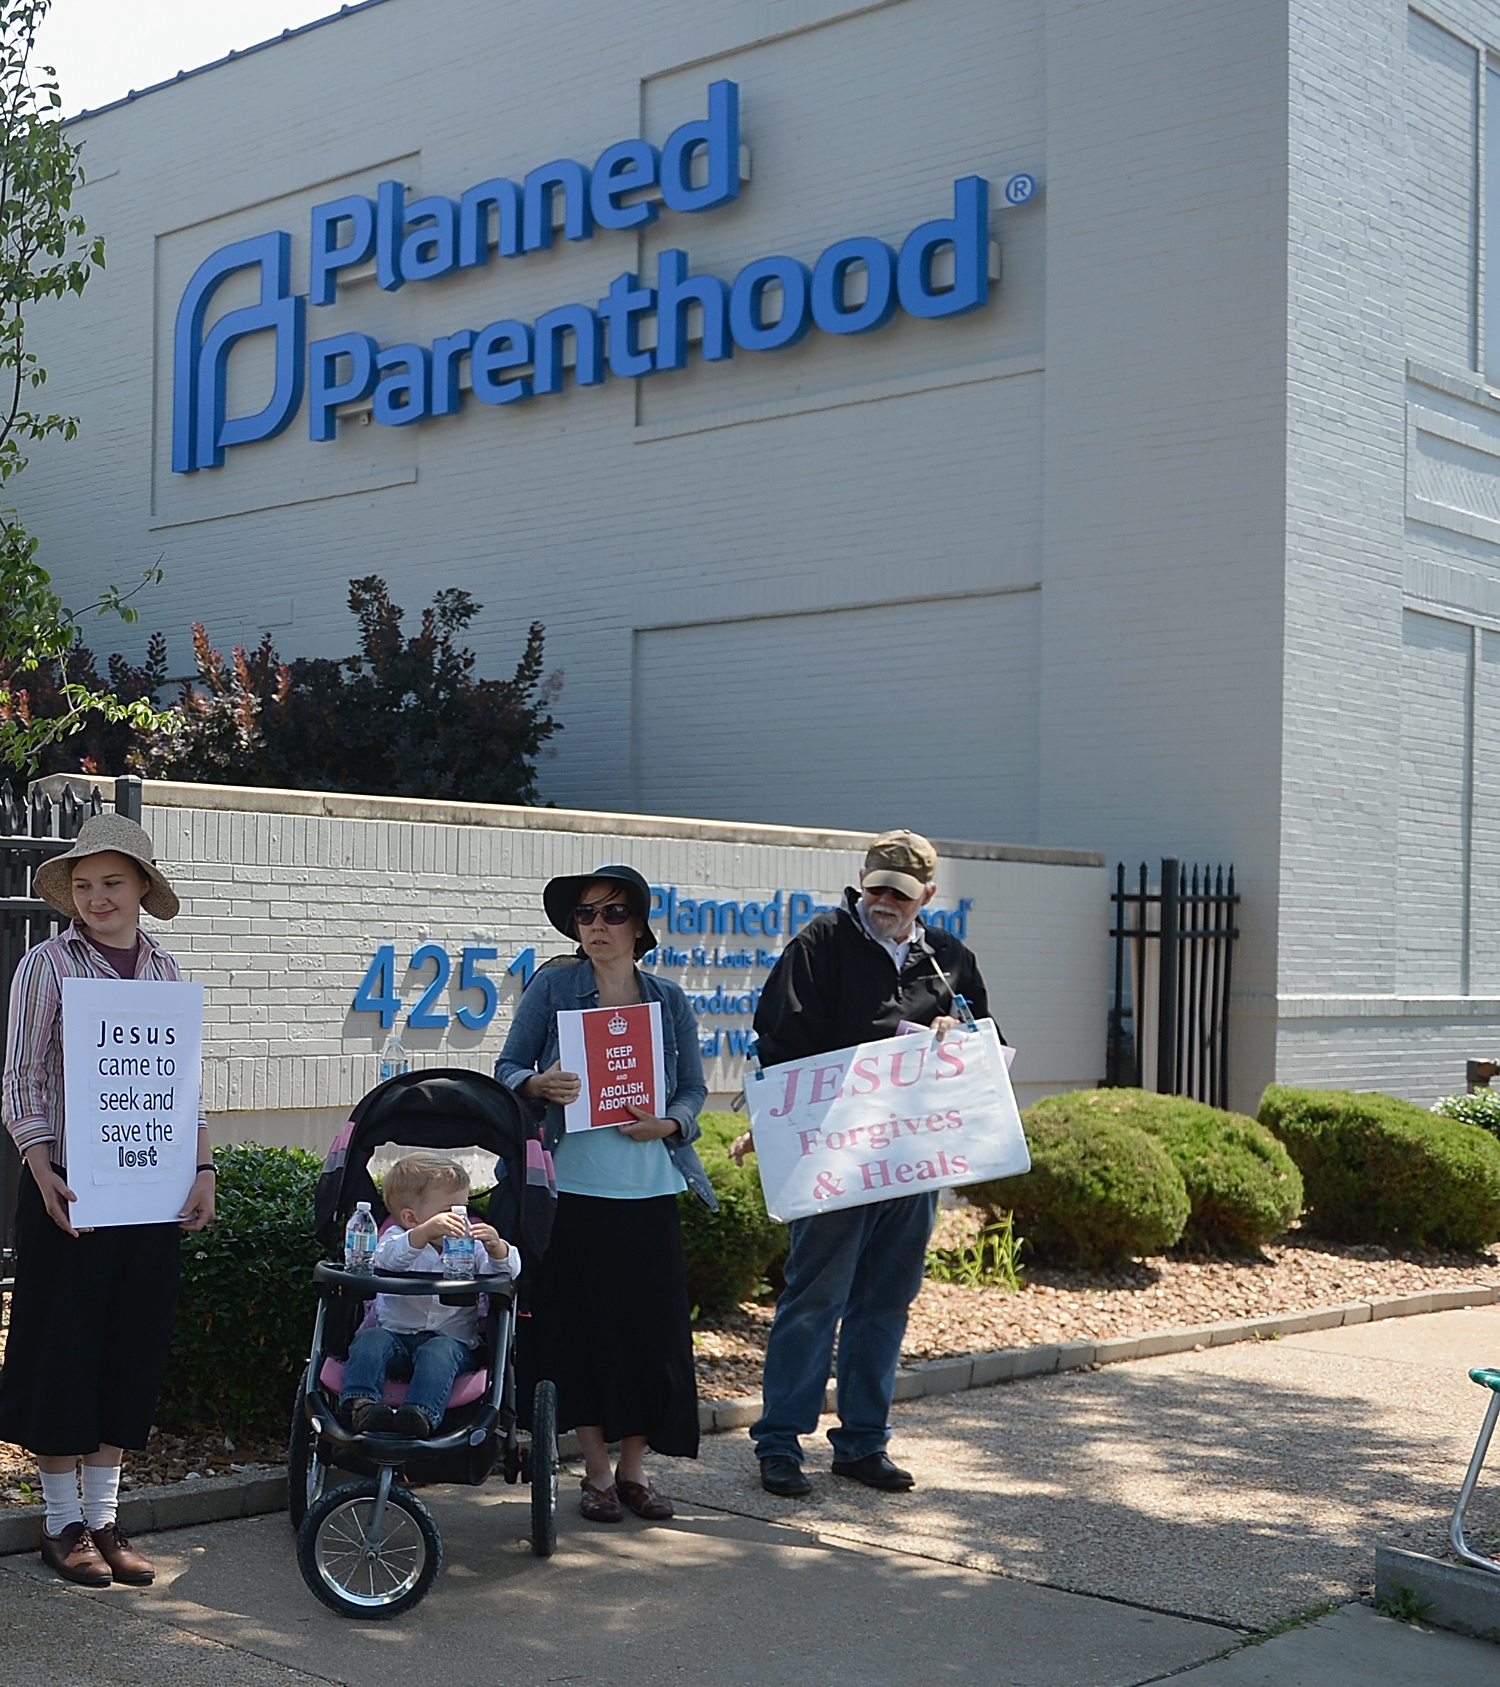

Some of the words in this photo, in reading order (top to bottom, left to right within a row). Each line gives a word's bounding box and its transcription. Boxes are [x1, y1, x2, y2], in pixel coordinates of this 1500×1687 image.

[311, 79, 741, 306] Planned
[309, 175, 990, 442] Parenthood
[649, 885, 783, 936] Planned
[643, 945, 660, 966] of
[663, 946, 689, 966] the
[714, 947, 753, 967] Louis
[97, 1020, 176, 1047] Jesus
[605, 1045, 633, 1059] KEEP
[607, 1058, 637, 1071] CALM
[99, 1057, 150, 1076] came
[156, 1055, 175, 1076] to
[616, 1073, 628, 1081] AND
[600, 1082, 644, 1098] ABOLISH
[770, 1040, 966, 1117] JESUS
[99, 1086, 140, 1111] seek
[143, 1086, 174, 1111] and
[598, 1094, 649, 1111] ABORTION
[101, 1124, 141, 1143] save
[146, 1117, 173, 1142] the
[796, 1109, 964, 1156] Forgives
[118, 1145, 158, 1167] lost
[813, 1170, 846, 1200] &
[858, 1150, 970, 1191] Heals
